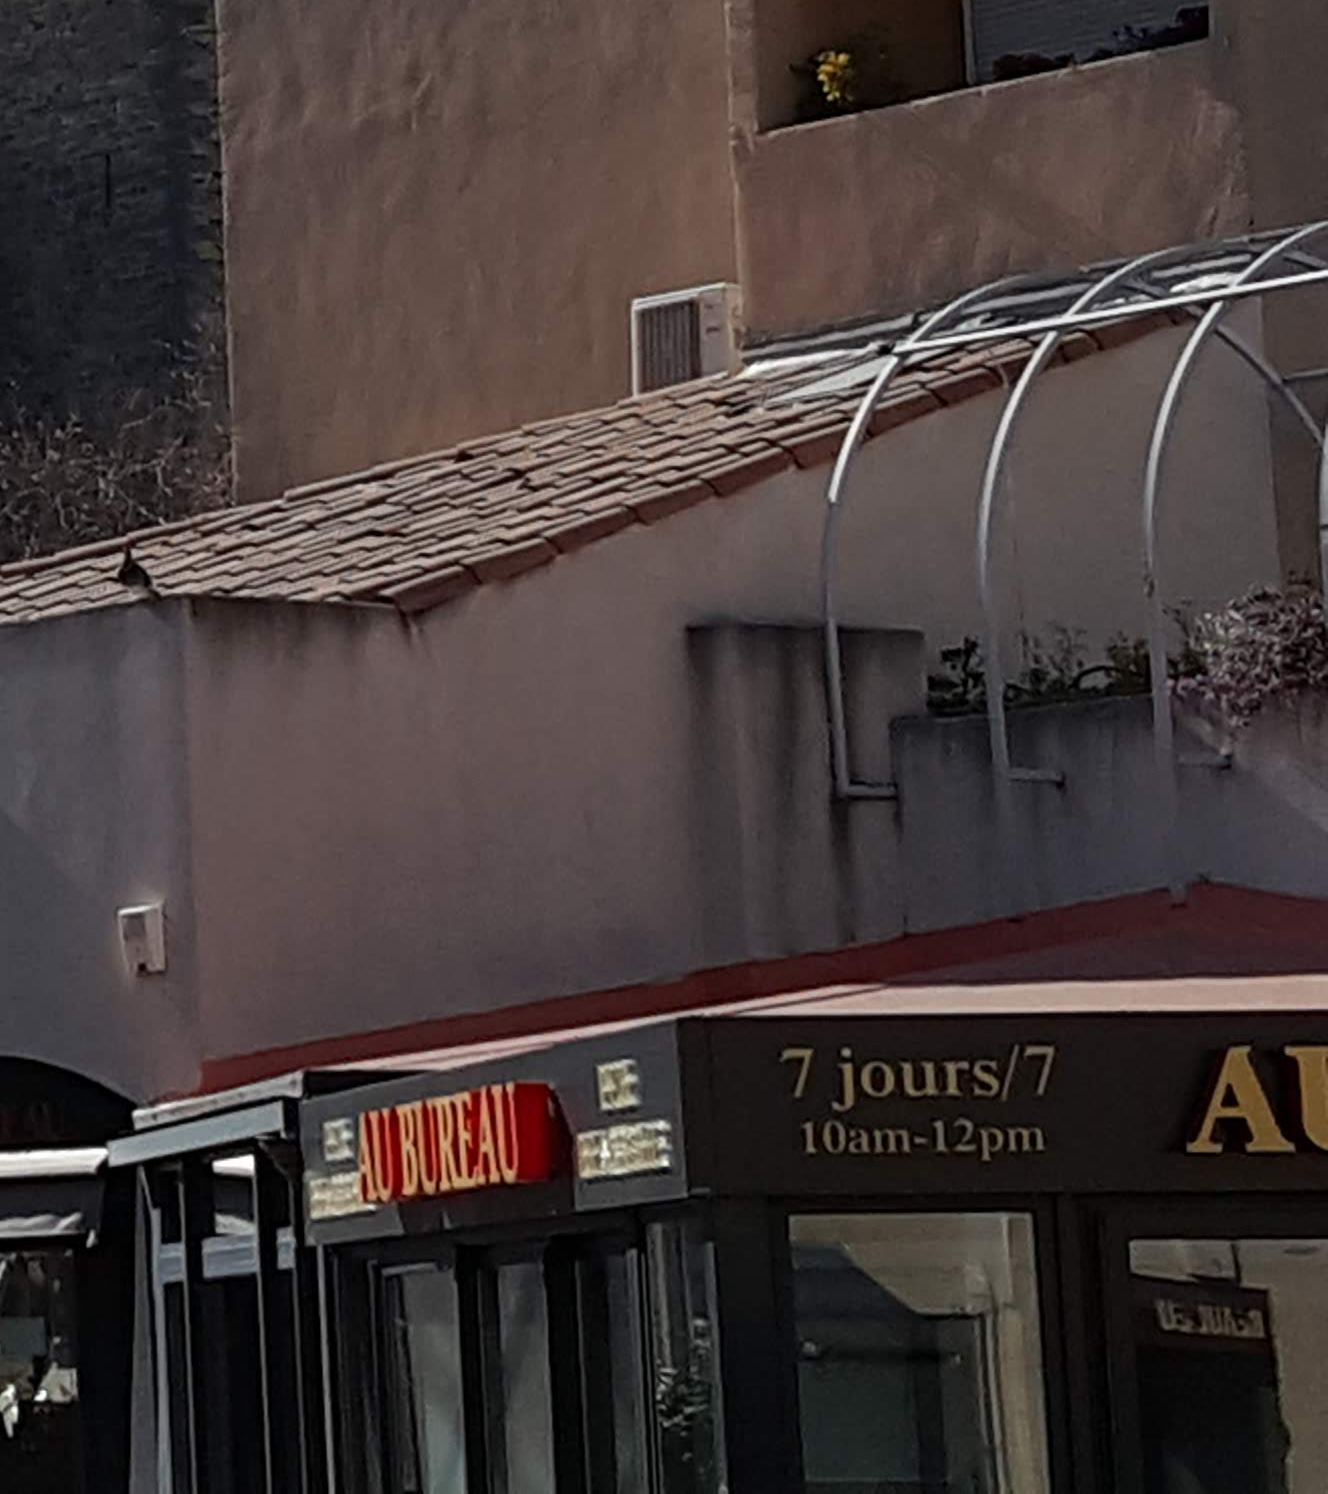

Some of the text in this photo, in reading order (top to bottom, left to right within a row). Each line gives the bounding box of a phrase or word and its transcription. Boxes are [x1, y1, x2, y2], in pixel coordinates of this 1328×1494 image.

[779, 1043, 1058, 1111] 7 jours/7
[357, 1107, 396, 1204] AU
[395, 1082, 520, 1197] BUREAU
[800, 1118, 1046, 1162] 10am-12pm
